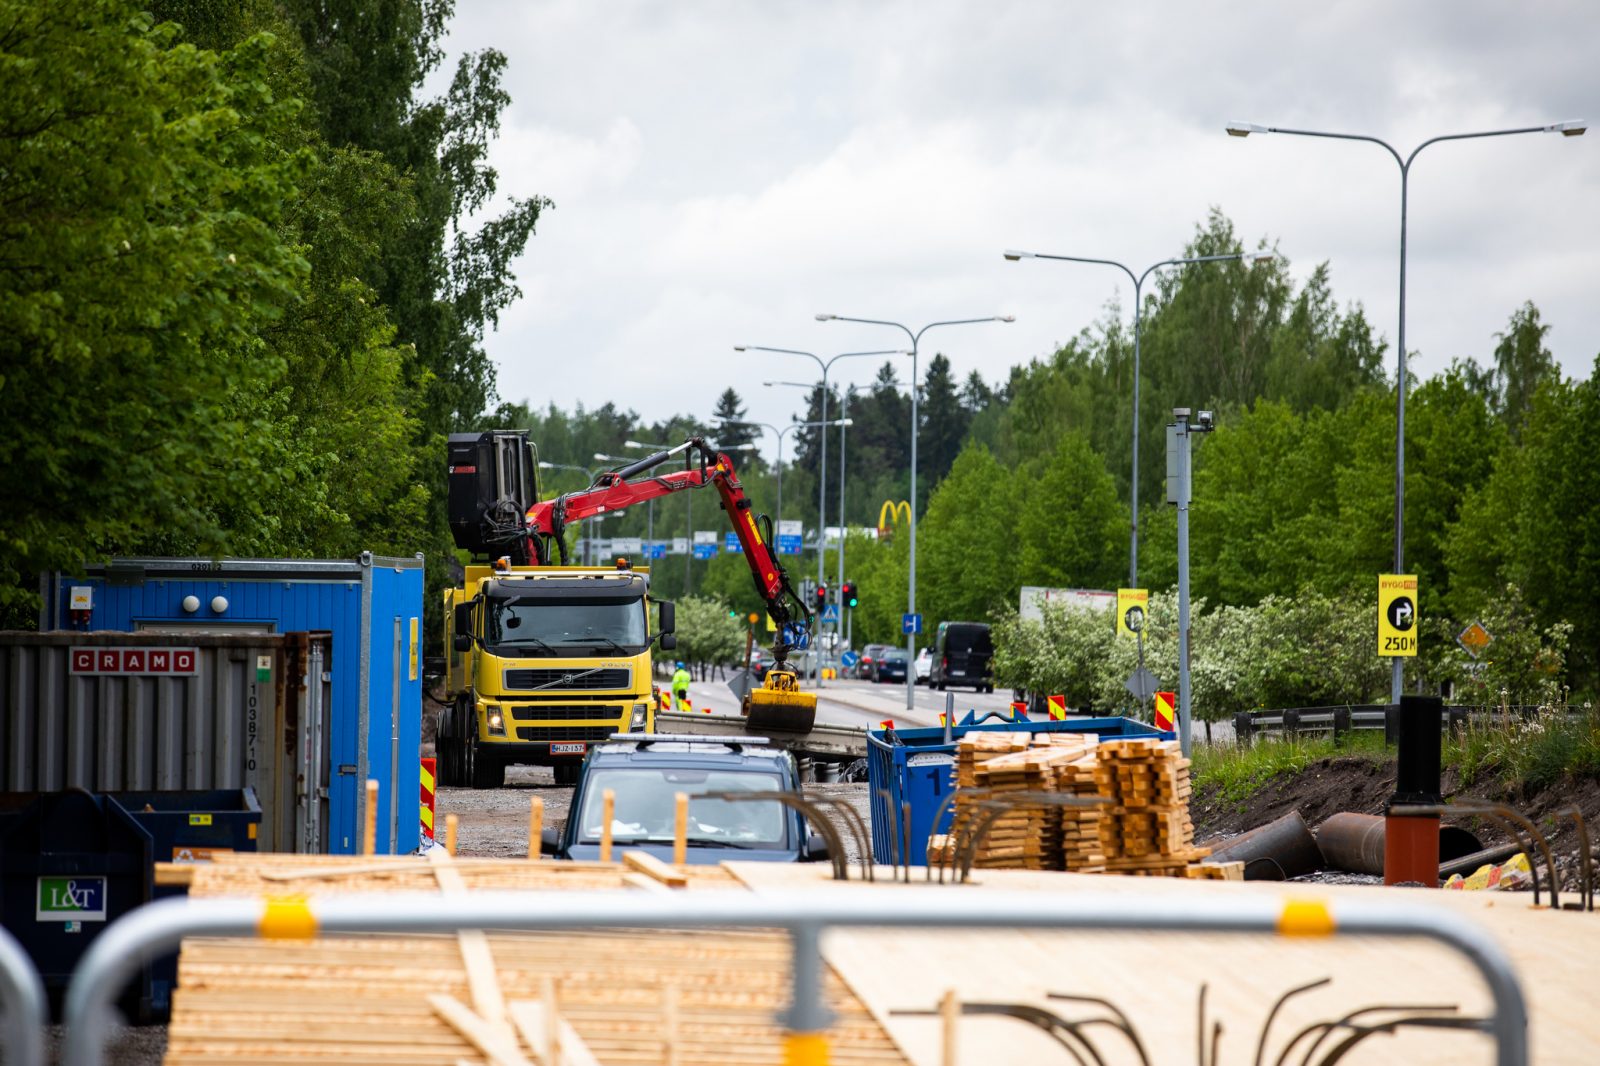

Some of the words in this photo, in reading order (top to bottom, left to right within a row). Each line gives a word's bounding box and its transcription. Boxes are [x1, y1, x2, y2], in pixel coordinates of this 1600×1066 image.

[1385, 637, 1408, 651] 250
[78, 655, 190, 668] CRAMO
[248, 683, 257, 771] 1038710
[926, 767, 941, 797] 1
[50, 880, 95, 908] L&T
